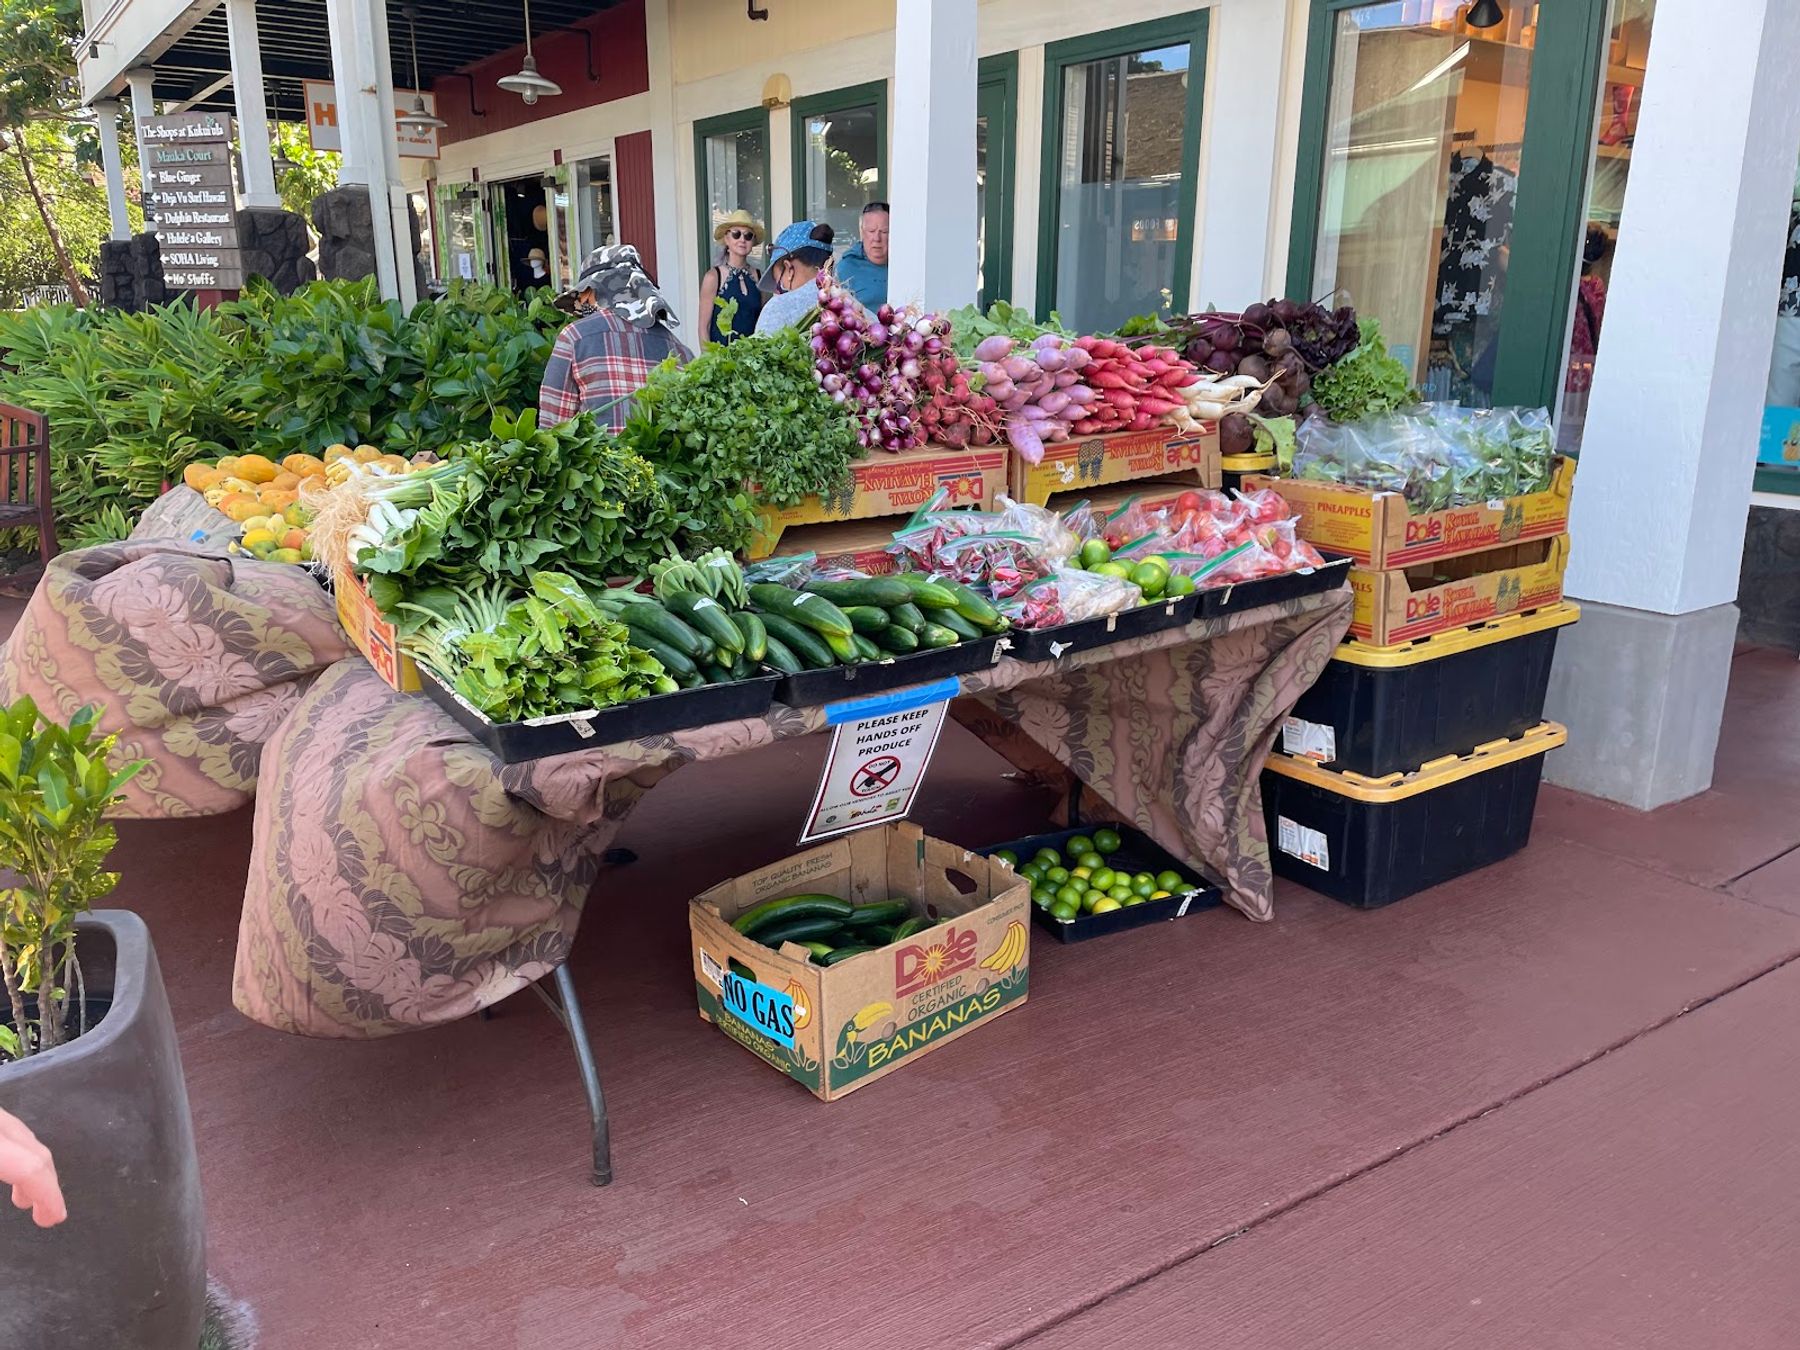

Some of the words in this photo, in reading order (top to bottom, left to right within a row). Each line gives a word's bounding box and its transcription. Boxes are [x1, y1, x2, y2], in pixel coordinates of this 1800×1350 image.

[178, 127, 186, 137] at
[157, 149, 185, 162] Mauka
[186, 148, 212, 161] Court
[159, 169, 176, 183] Blue
[176, 169, 202, 186] Ginger
[187, 191, 201, 204] Surf
[164, 210, 192, 226] Dolphin
[192, 211, 230, 223] Restaurant
[195, 231, 223, 246] Gallery
[169, 252, 195, 265] SOHA
[195, 252, 219, 267] Living
[187, 272, 216, 285] Stuffs
[1167, 443, 1200, 467] Dole
[1317, 502, 1372, 518] PINEAPPLES
[1406, 516, 1442, 542] Dole
[1406, 592, 1441, 618] Dole
[857, 715, 899, 731] PLEASE
[901, 709, 929, 722] KEEP
[856, 729, 898, 745] HANDS
[900, 723, 923, 735] OFF
[857, 738, 913, 757] PRODUCE
[752, 876, 768, 887] TOP
[770, 862, 802, 881] QUALITY
[806, 852, 833, 867] FRESH
[755, 875, 791, 895] ORGANIC
[791, 861, 832, 881] BANANAS
[895, 926, 978, 988] Dole
[912, 975, 963, 1006] CERTIFIED
[723, 974, 747, 1013] NO
[752, 991, 795, 1039] GAS
[907, 985, 968, 1022] ORGANIC
[724, 1013, 775, 1052] BANANAS
[868, 988, 1001, 1069] BANANAS
